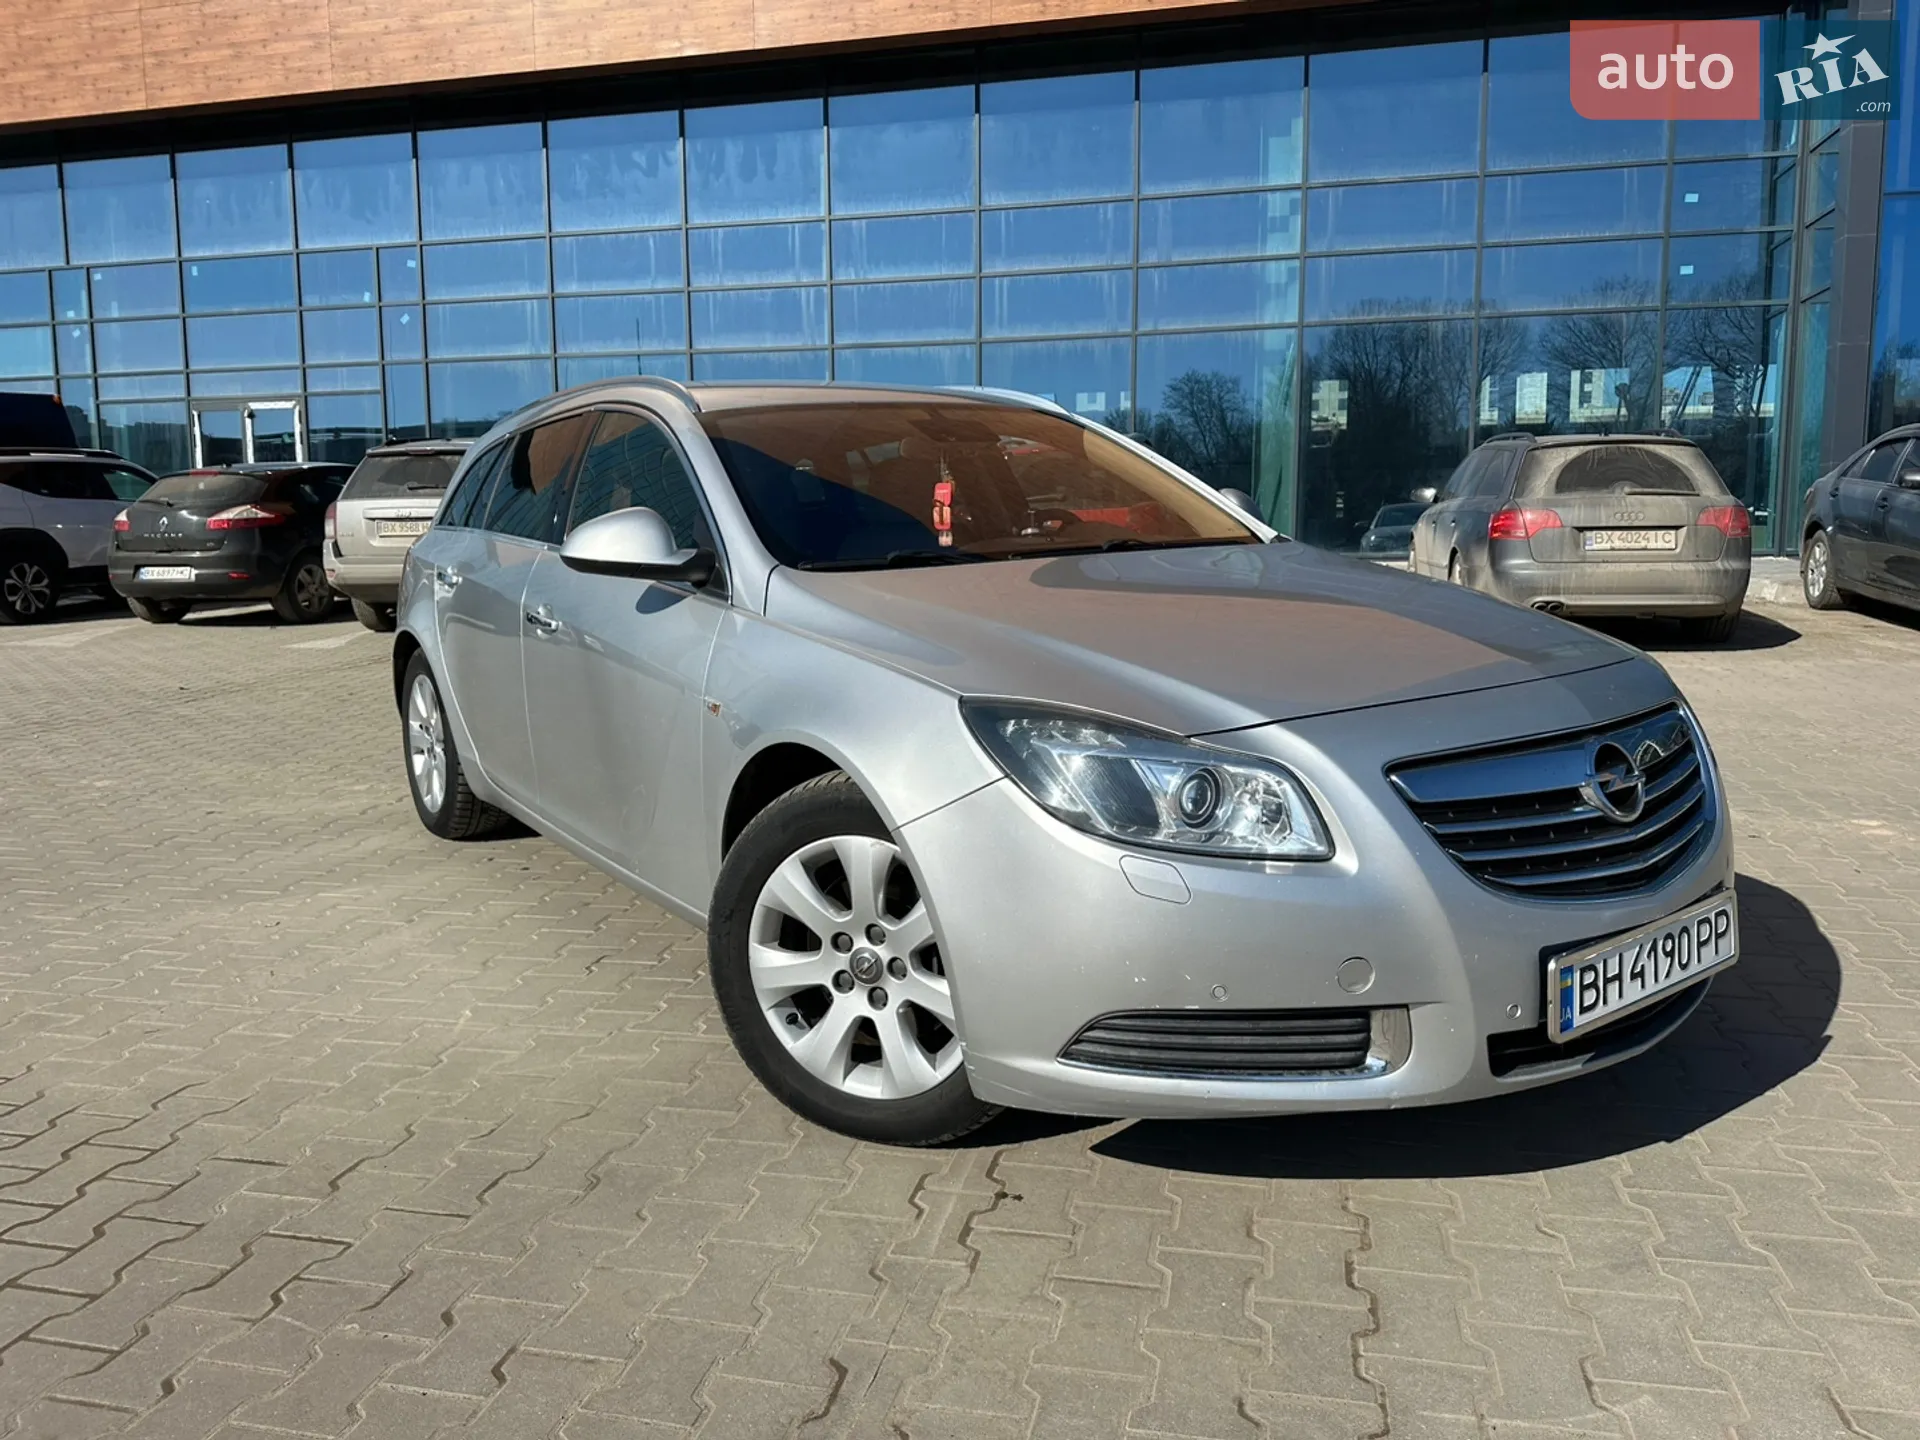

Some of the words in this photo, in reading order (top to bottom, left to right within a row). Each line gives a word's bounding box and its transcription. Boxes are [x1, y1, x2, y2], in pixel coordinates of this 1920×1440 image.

[382, 522, 396, 533] BX
[1594, 532, 1614, 544] BX
[1617, 532, 1650, 544] 4024
[1654, 531, 1673, 544] IC
[1579, 952, 1624, 1016] BH
[1629, 925, 1691, 990] 4190
[1696, 908, 1730, 964] PP
